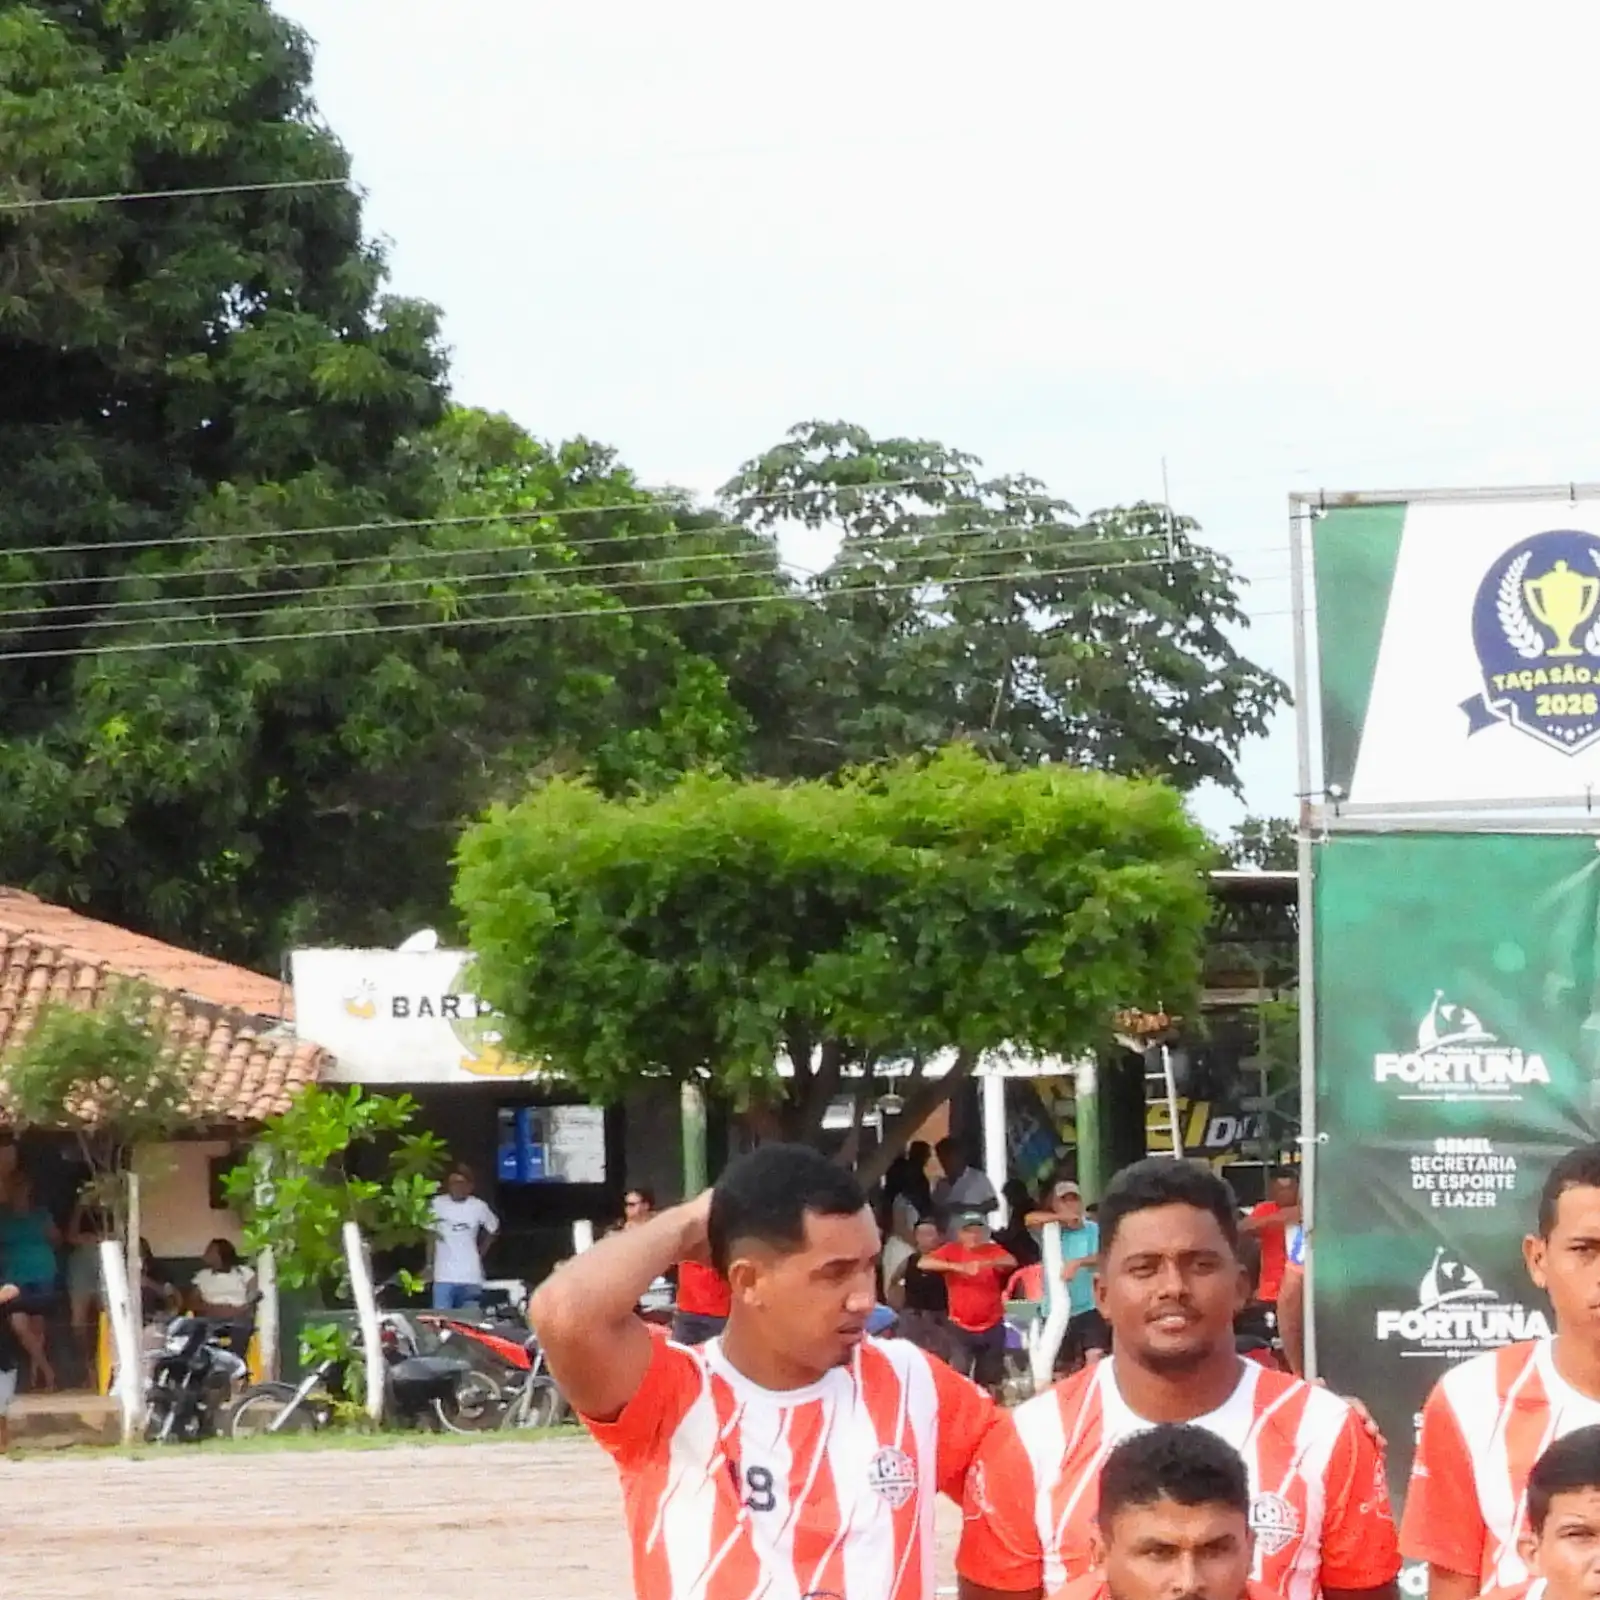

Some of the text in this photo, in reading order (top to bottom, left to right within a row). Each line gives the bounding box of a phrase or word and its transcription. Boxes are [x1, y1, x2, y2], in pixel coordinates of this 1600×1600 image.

[1492, 668, 1548, 692] TAÇA
[1535, 692, 1598, 716] 2026
[392, 995, 461, 1019] BAR
[1374, 1053, 1551, 1083] FORTUNA
[1410, 1155, 1517, 1173] SECRETARIA
[1412, 1173, 1516, 1190] DE ESPORTE
[1431, 1191, 1497, 1207] E LAZER
[1376, 1310, 1551, 1340] FORTUNA
